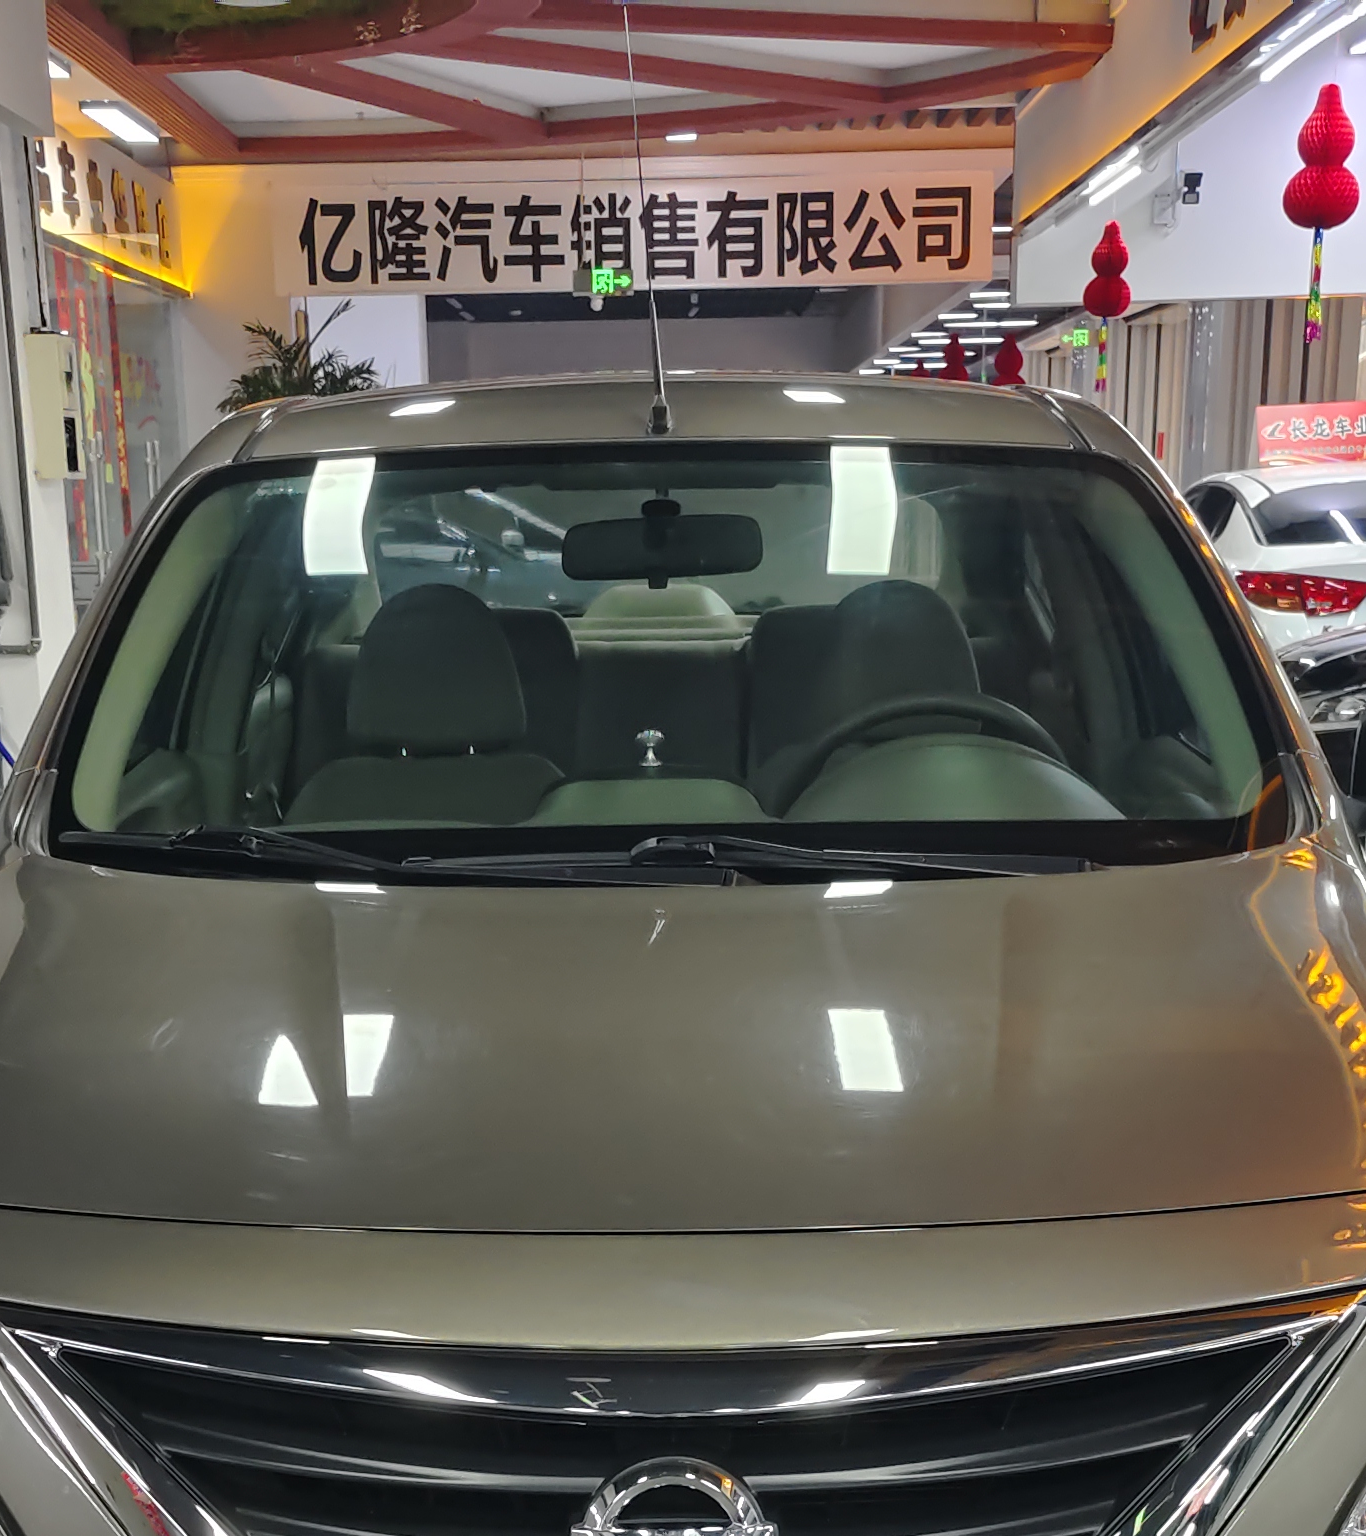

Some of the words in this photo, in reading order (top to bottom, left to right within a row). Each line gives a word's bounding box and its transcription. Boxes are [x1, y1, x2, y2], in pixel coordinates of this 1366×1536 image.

[298, 186, 973, 286] 亿隆汽车销售有限公司
